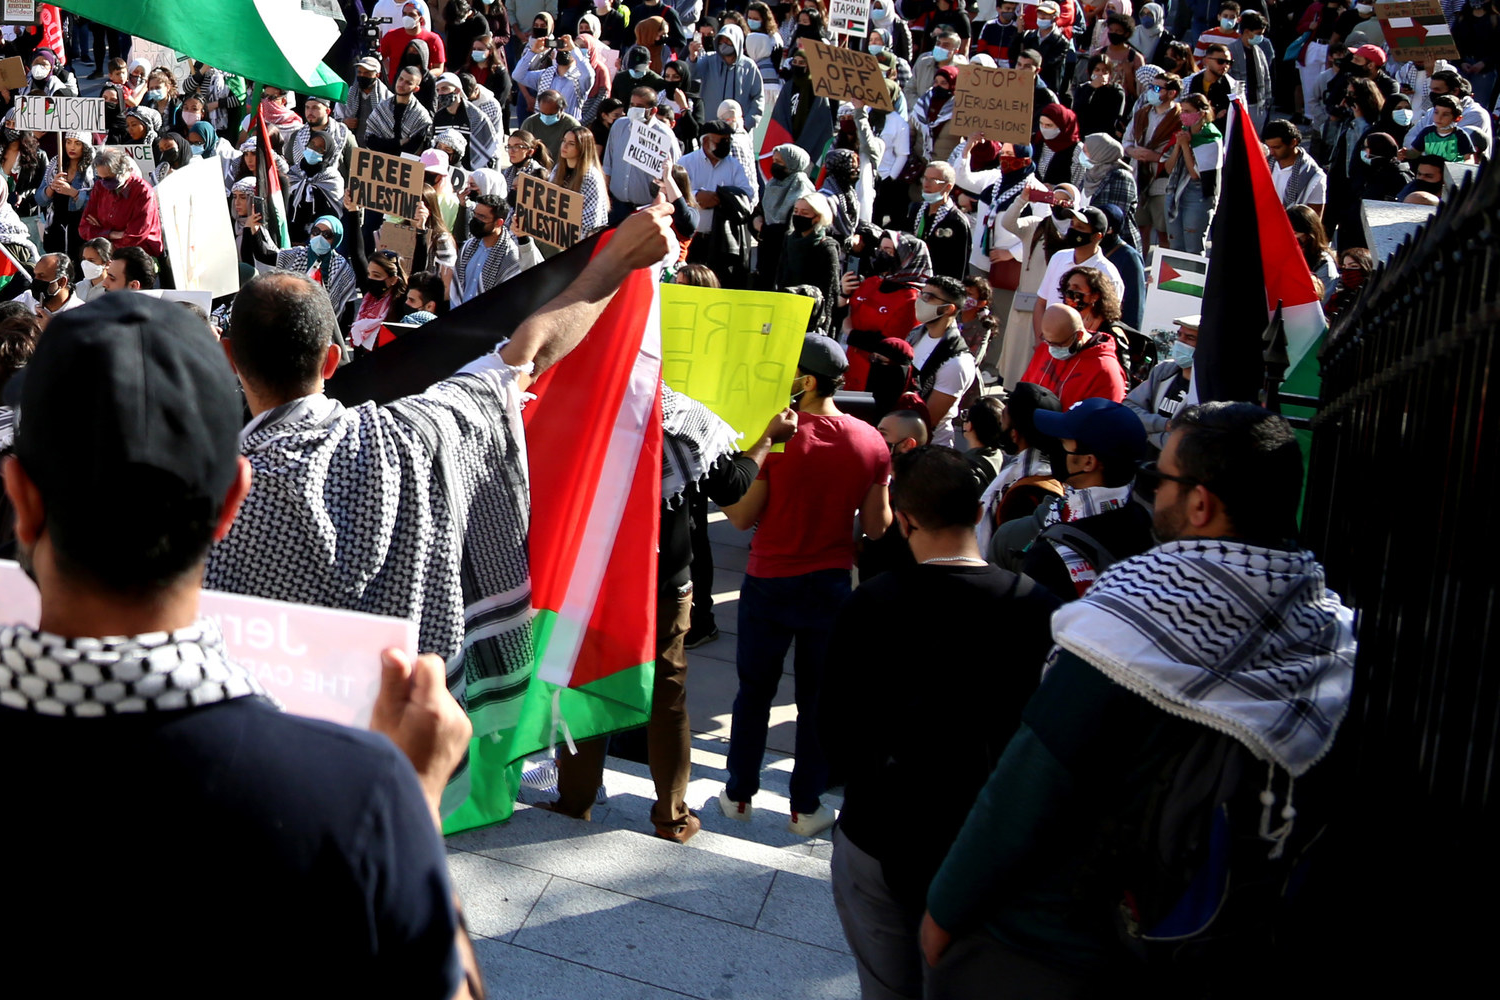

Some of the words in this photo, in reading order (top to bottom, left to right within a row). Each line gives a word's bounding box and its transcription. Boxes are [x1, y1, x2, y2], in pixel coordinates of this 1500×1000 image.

[814, 42, 877, 72] HANDS
[826, 63, 871, 86] OFF
[971, 67, 1017, 87] STOP
[815, 76, 888, 107] AL-AQSA
[954, 89, 1029, 113] JERUSALEM
[14, 96, 42, 130] FREE
[45, 96, 106, 132] PALESTINE
[954, 110, 1026, 134] EXPULSIONS
[637, 125, 647, 137] ALL
[647, 130, 657, 142] FOR
[657, 136, 662, 145] A
[638, 136, 659, 153] UNITED
[627, 144, 664, 172] PALESTINE
[1425, 140, 1456, 158] NIKE
[356, 151, 412, 189] FREE
[521, 177, 571, 220] FREE
[516, 202, 580, 248] PALESTINE
